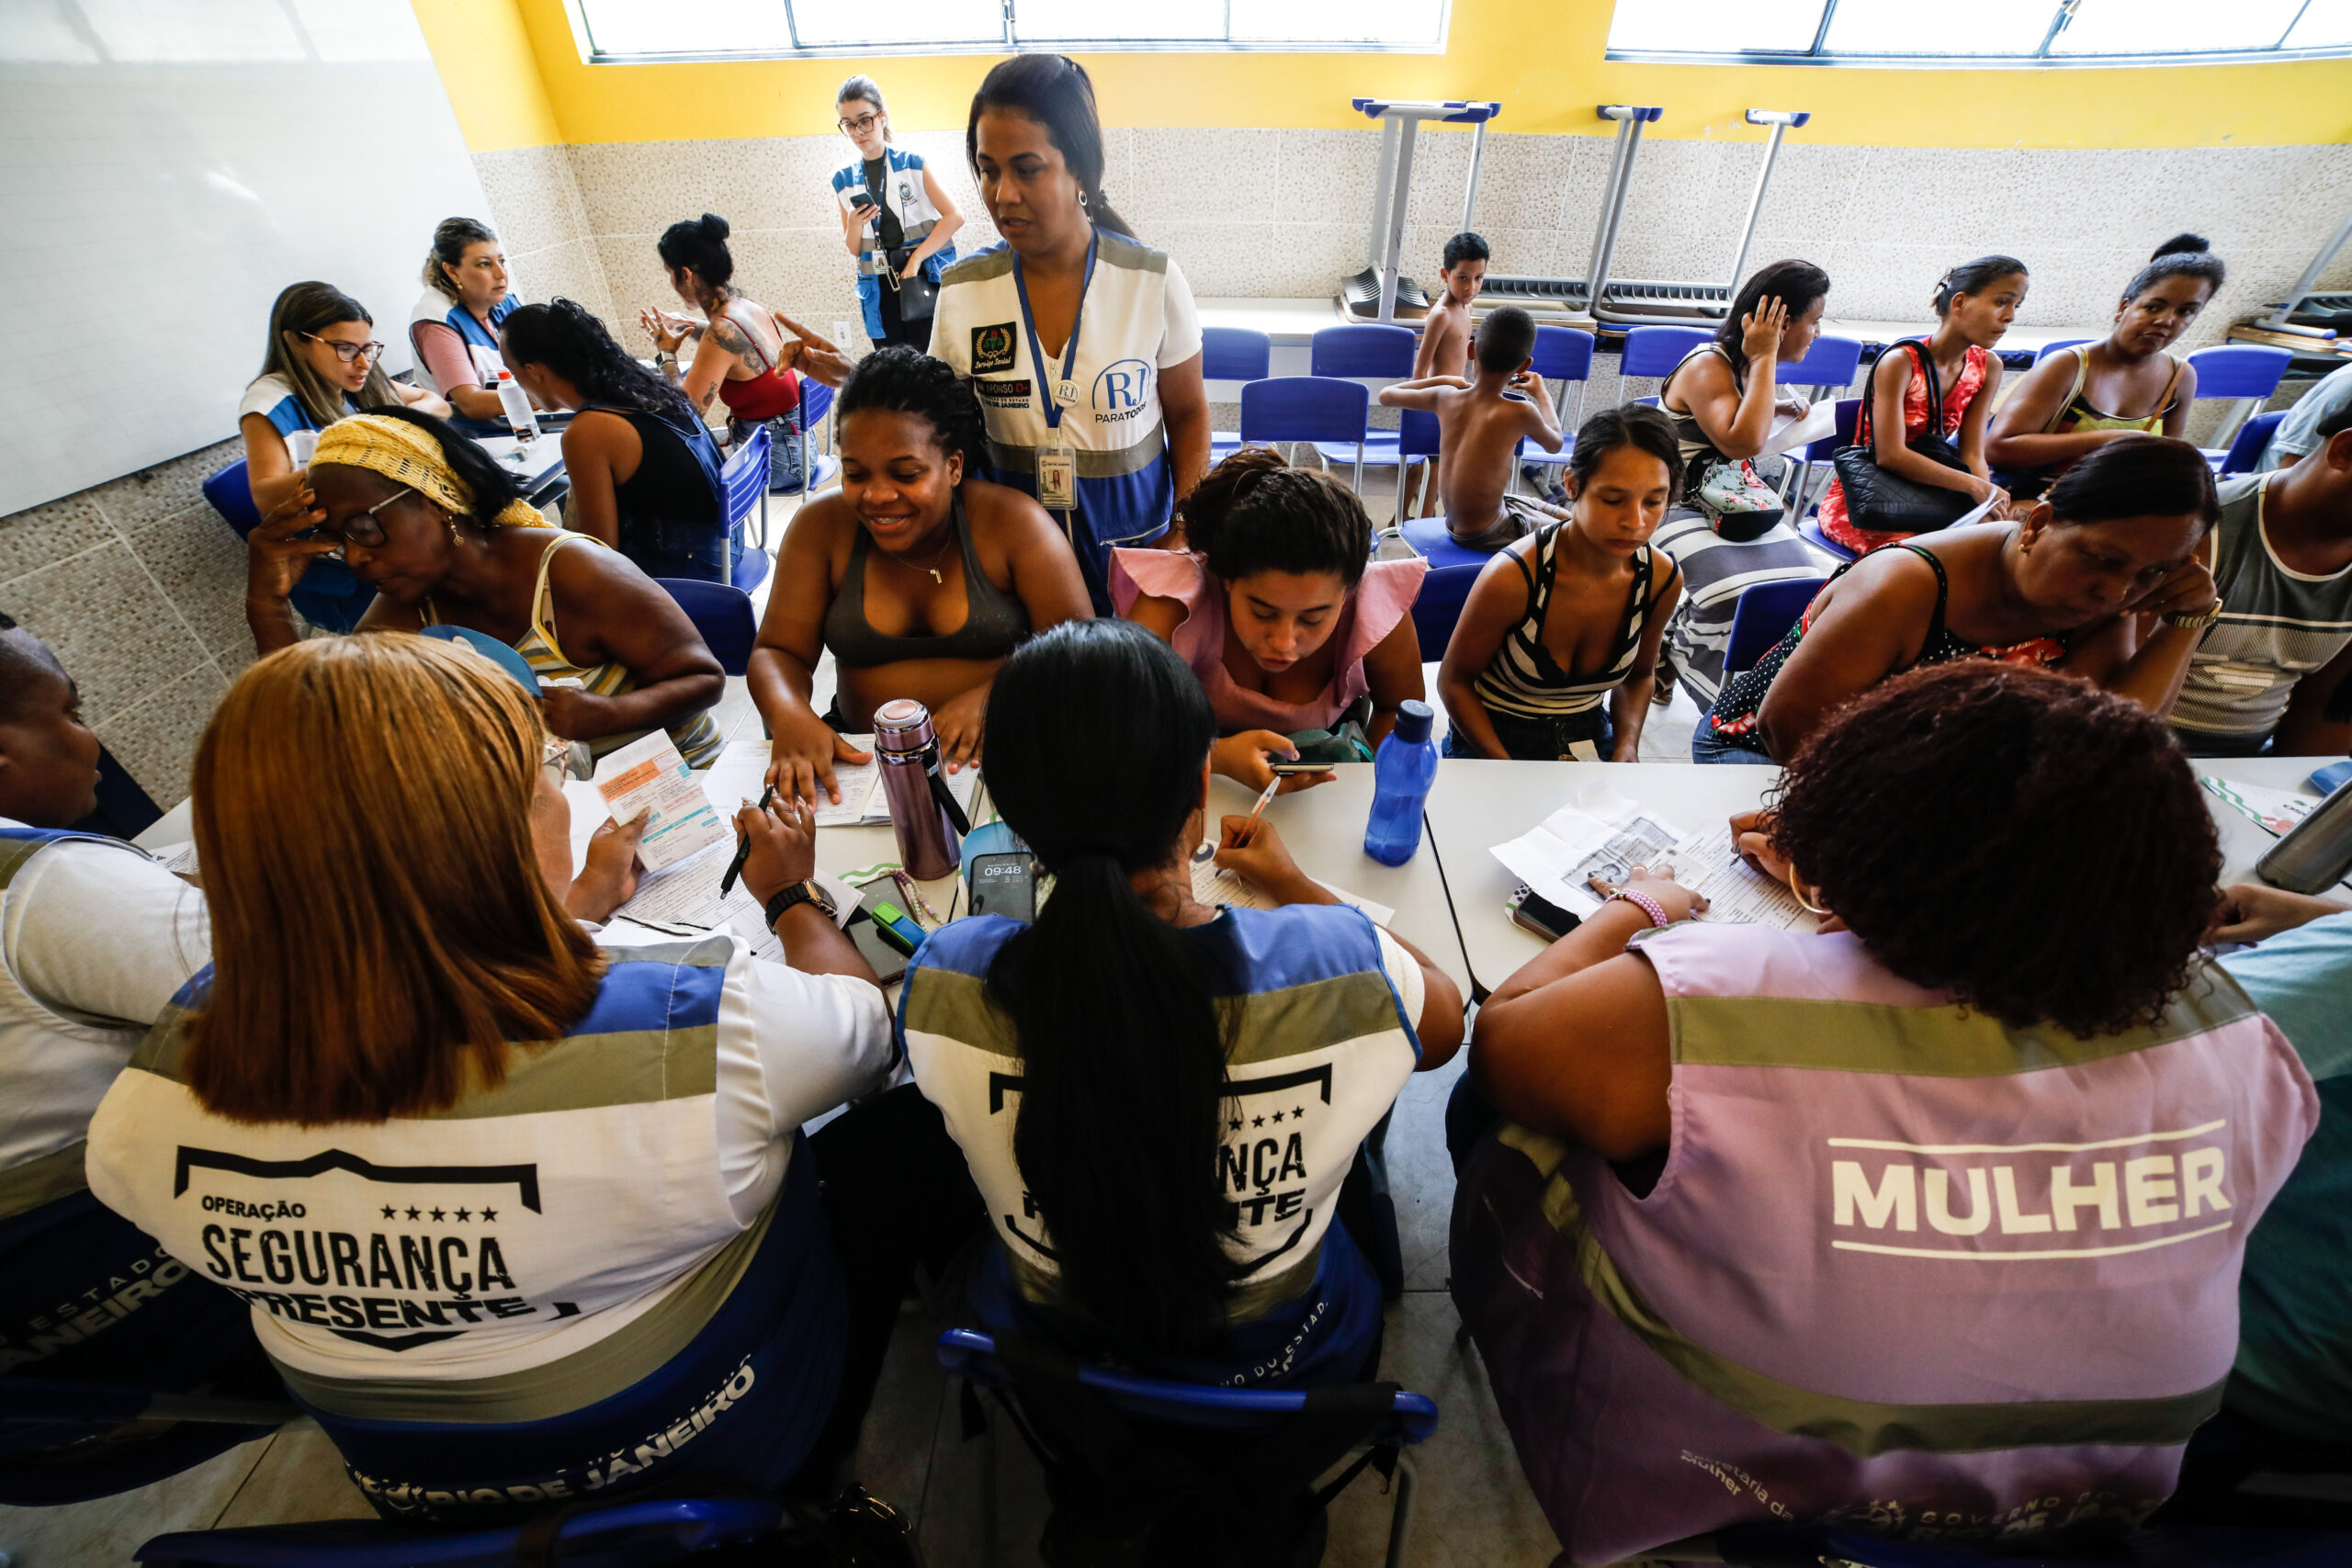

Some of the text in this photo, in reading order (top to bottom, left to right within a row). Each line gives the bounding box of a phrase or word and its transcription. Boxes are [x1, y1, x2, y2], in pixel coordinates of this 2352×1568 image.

[994, 356, 1012, 367] Social
[984, 865, 1022, 876] 09:48
[201, 1195, 306, 1222] OPERAÇÃO
[1832, 1146, 2233, 1236] MULHER
[201, 1224, 516, 1301] SEGURANÇA
[227, 1287, 537, 1329] PRESENTE
[583, 1364, 755, 1491] JANEIRO
